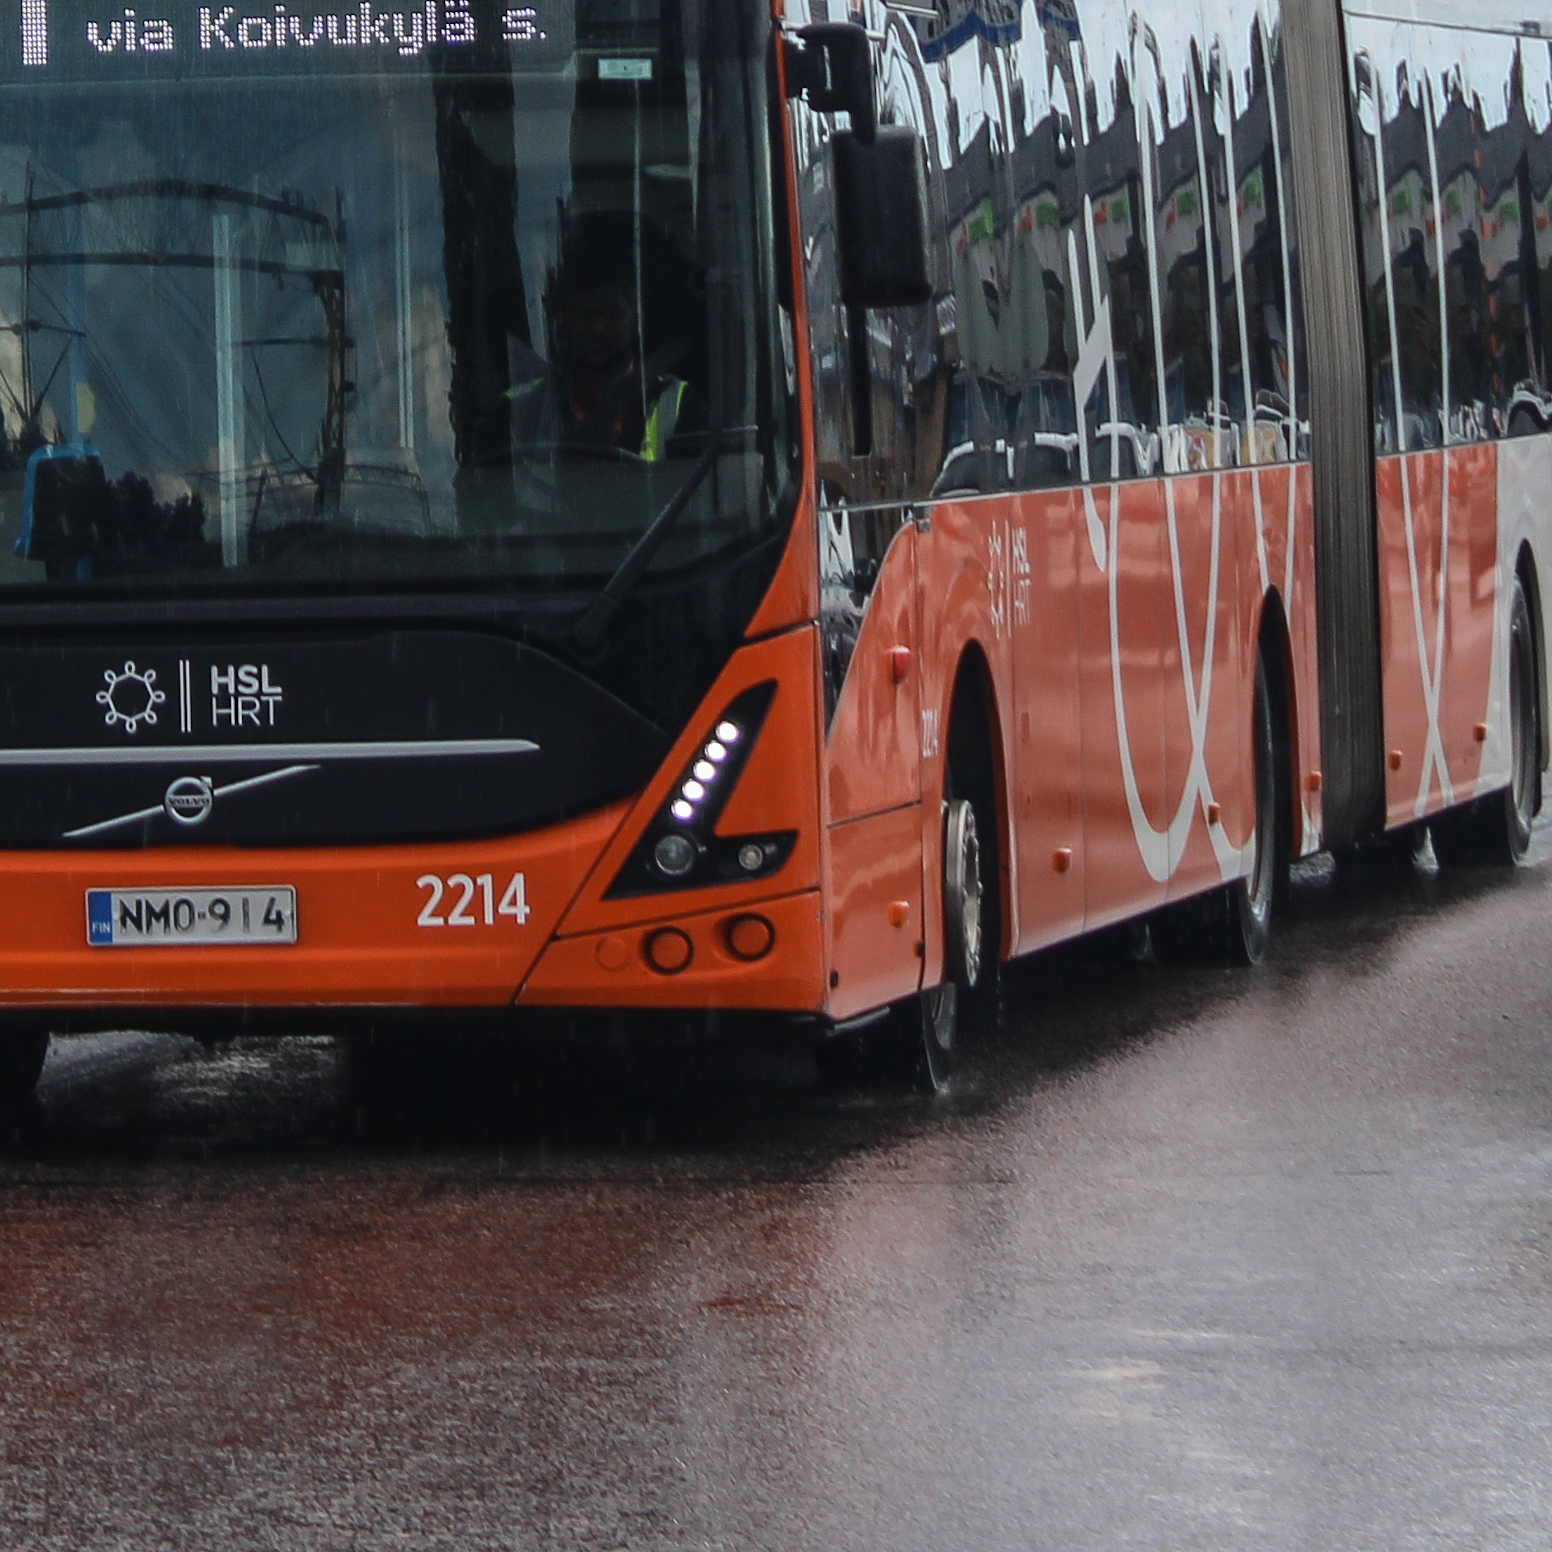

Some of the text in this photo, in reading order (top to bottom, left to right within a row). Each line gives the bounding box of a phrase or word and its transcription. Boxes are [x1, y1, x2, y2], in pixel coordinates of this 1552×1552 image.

[86, 0, 547, 56] via Koivukylä s.
[210, 663, 283, 695] HSL
[211, 695, 283, 727] HRT
[168, 796, 211, 807] VOLVO
[91, 896, 285, 935] FIN NMO-914
[415, 871, 531, 927] 2214
